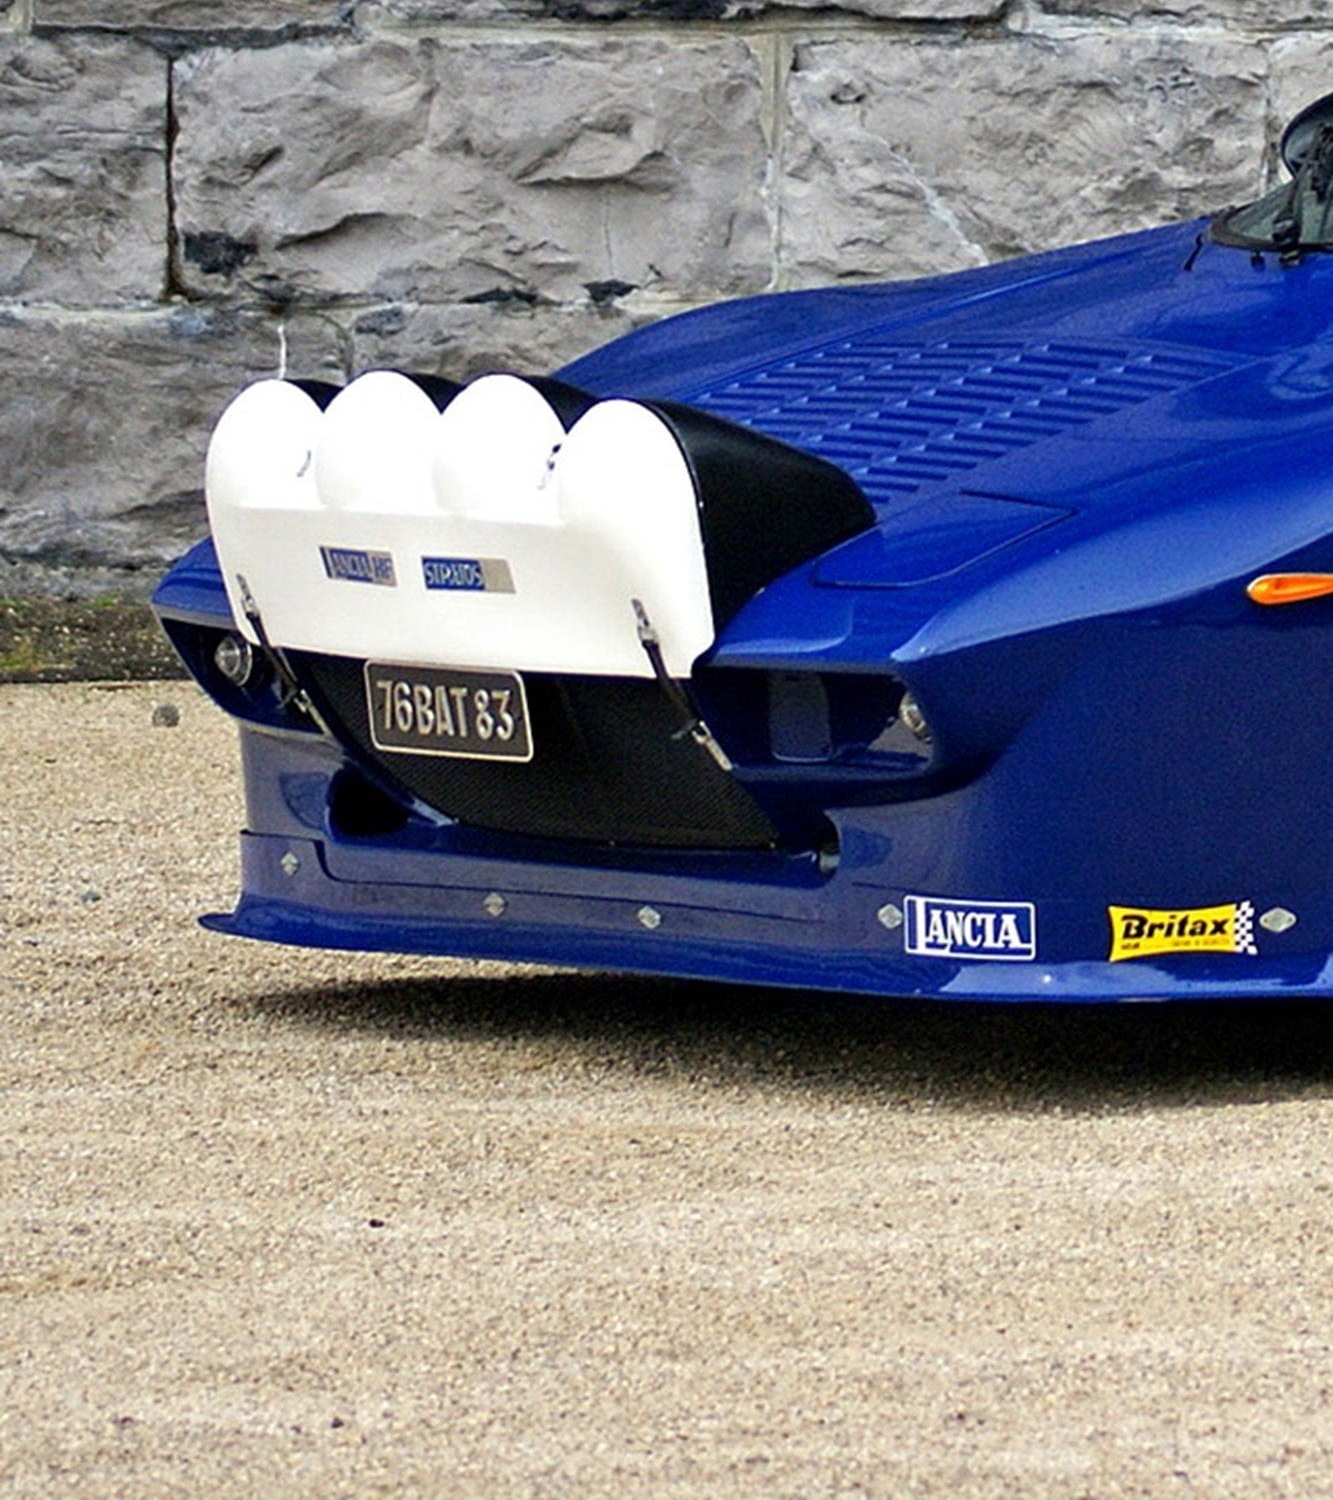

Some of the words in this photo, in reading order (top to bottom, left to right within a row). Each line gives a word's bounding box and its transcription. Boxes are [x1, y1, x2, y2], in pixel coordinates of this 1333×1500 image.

[423, 561, 484, 587] STRATOS
[914, 899, 1033, 953] LANCIA
[1121, 914, 1230, 939] Britax
